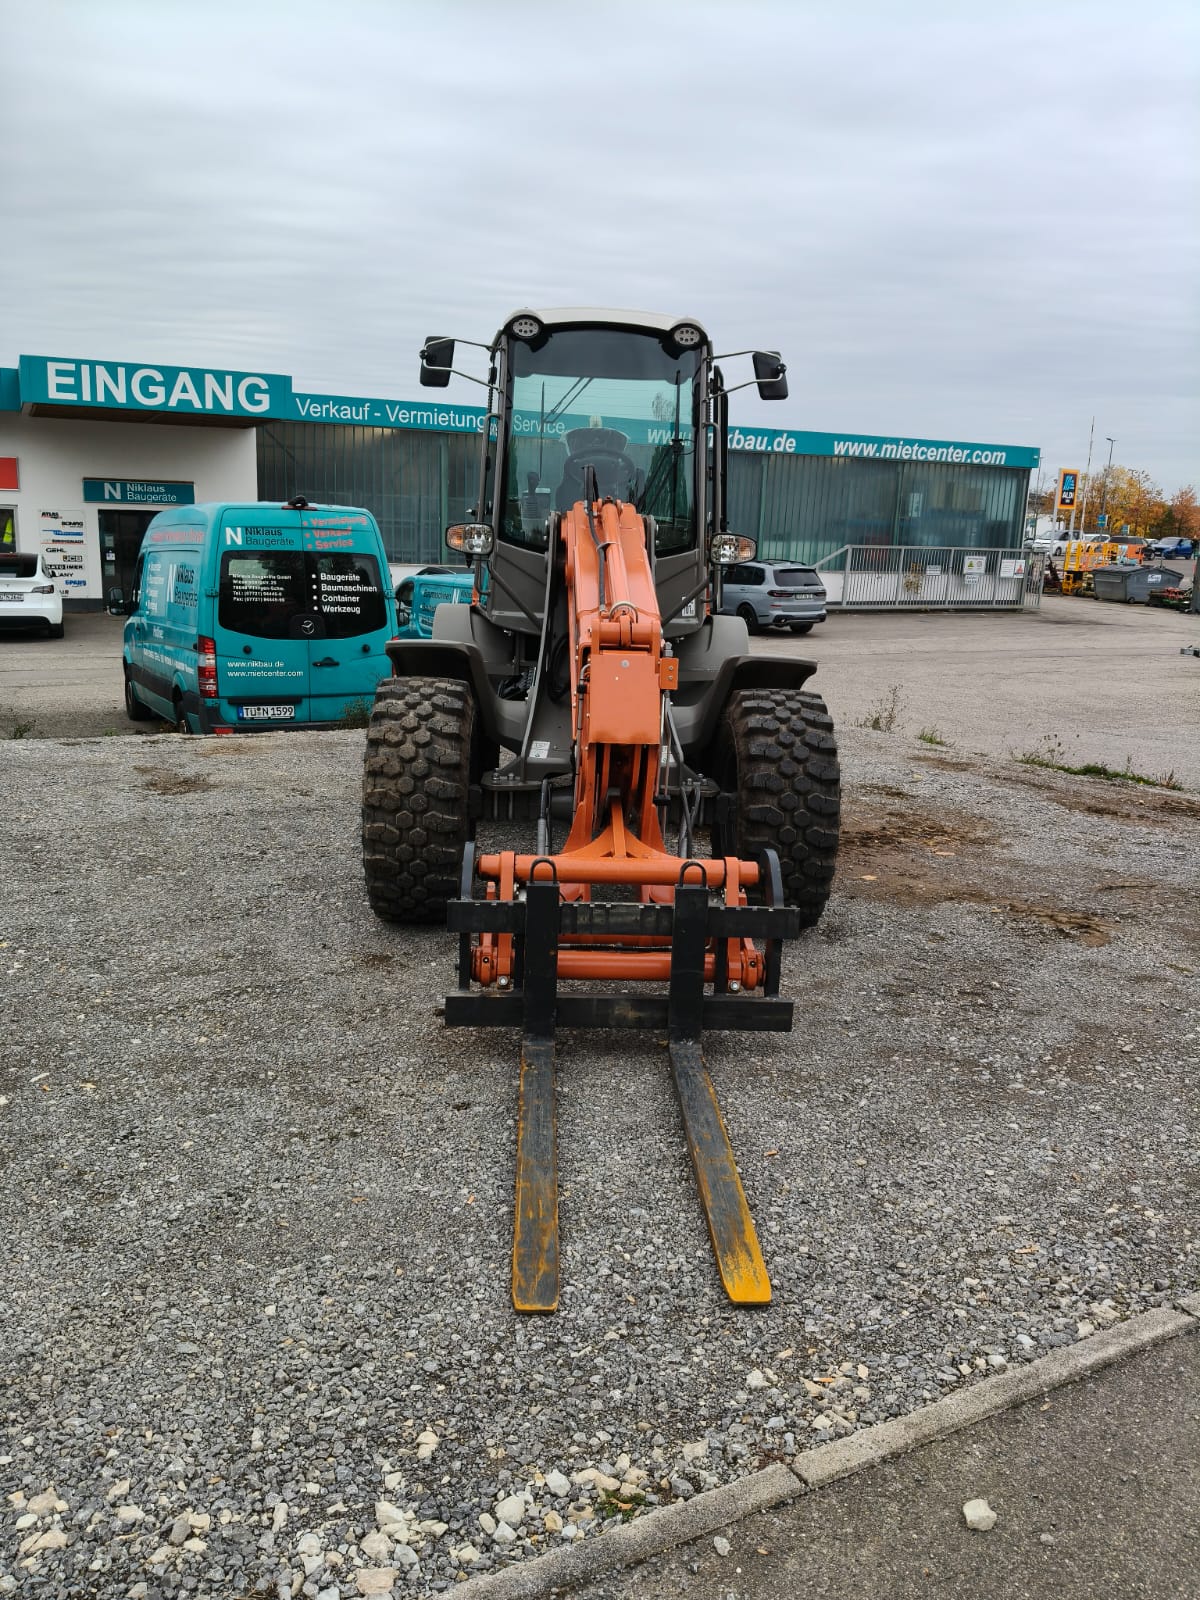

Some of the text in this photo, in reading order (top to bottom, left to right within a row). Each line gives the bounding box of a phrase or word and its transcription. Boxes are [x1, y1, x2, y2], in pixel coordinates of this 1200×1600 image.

[47, 362, 270, 413] EINGANG
[296, 398, 370, 420] Verkauf
[385, 404, 485, 433] Vermietung
[513, 414, 565, 434] Service
[833, 438, 1006, 465] www.mietcenter.com
[104, 482, 122, 500] N
[127, 483, 165, 493] Niklaus
[127, 492, 177, 502] Baugeräte
[225, 527, 242, 545] N
[245, 527, 282, 536] Niklaus
[245, 537, 294, 547] Baugeräte
[316, 539, 353, 549] Service
[320, 573, 361, 582] Baugeräte
[321, 583, 378, 593] Baumaschinen
[321, 594, 360, 603] Container
[322, 605, 361, 614] Werkzeug
[262, 707, 269, 716] N
[270, 706, 294, 716] 1599
